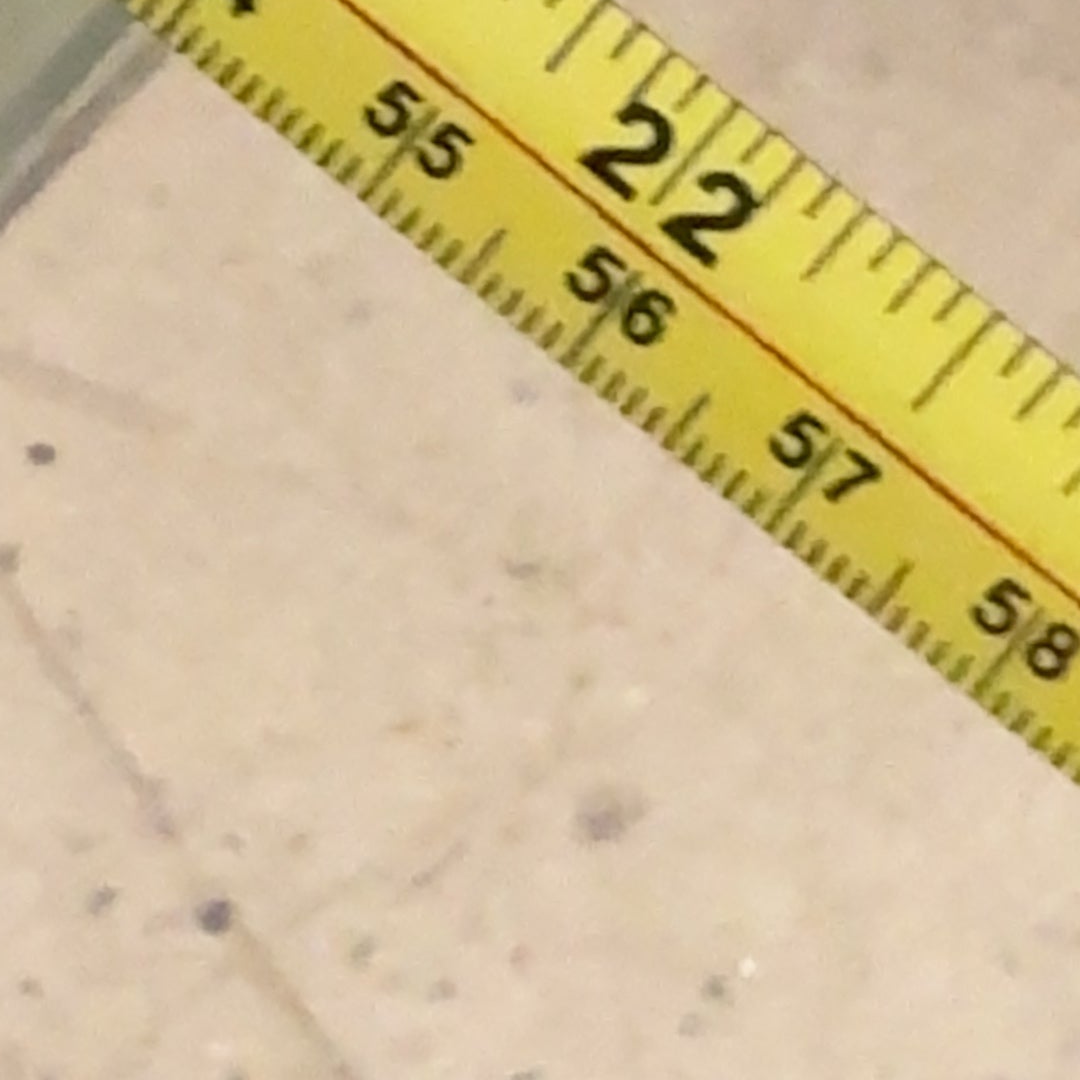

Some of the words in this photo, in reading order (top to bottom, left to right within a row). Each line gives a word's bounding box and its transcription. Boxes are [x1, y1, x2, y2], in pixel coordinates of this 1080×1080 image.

[363, 80, 475, 180] 55
[577, 101, 762, 268] 22
[565, 245, 677, 347] 56
[768, 411, 883, 504] 57
[969, 578, 1080, 681] 58
